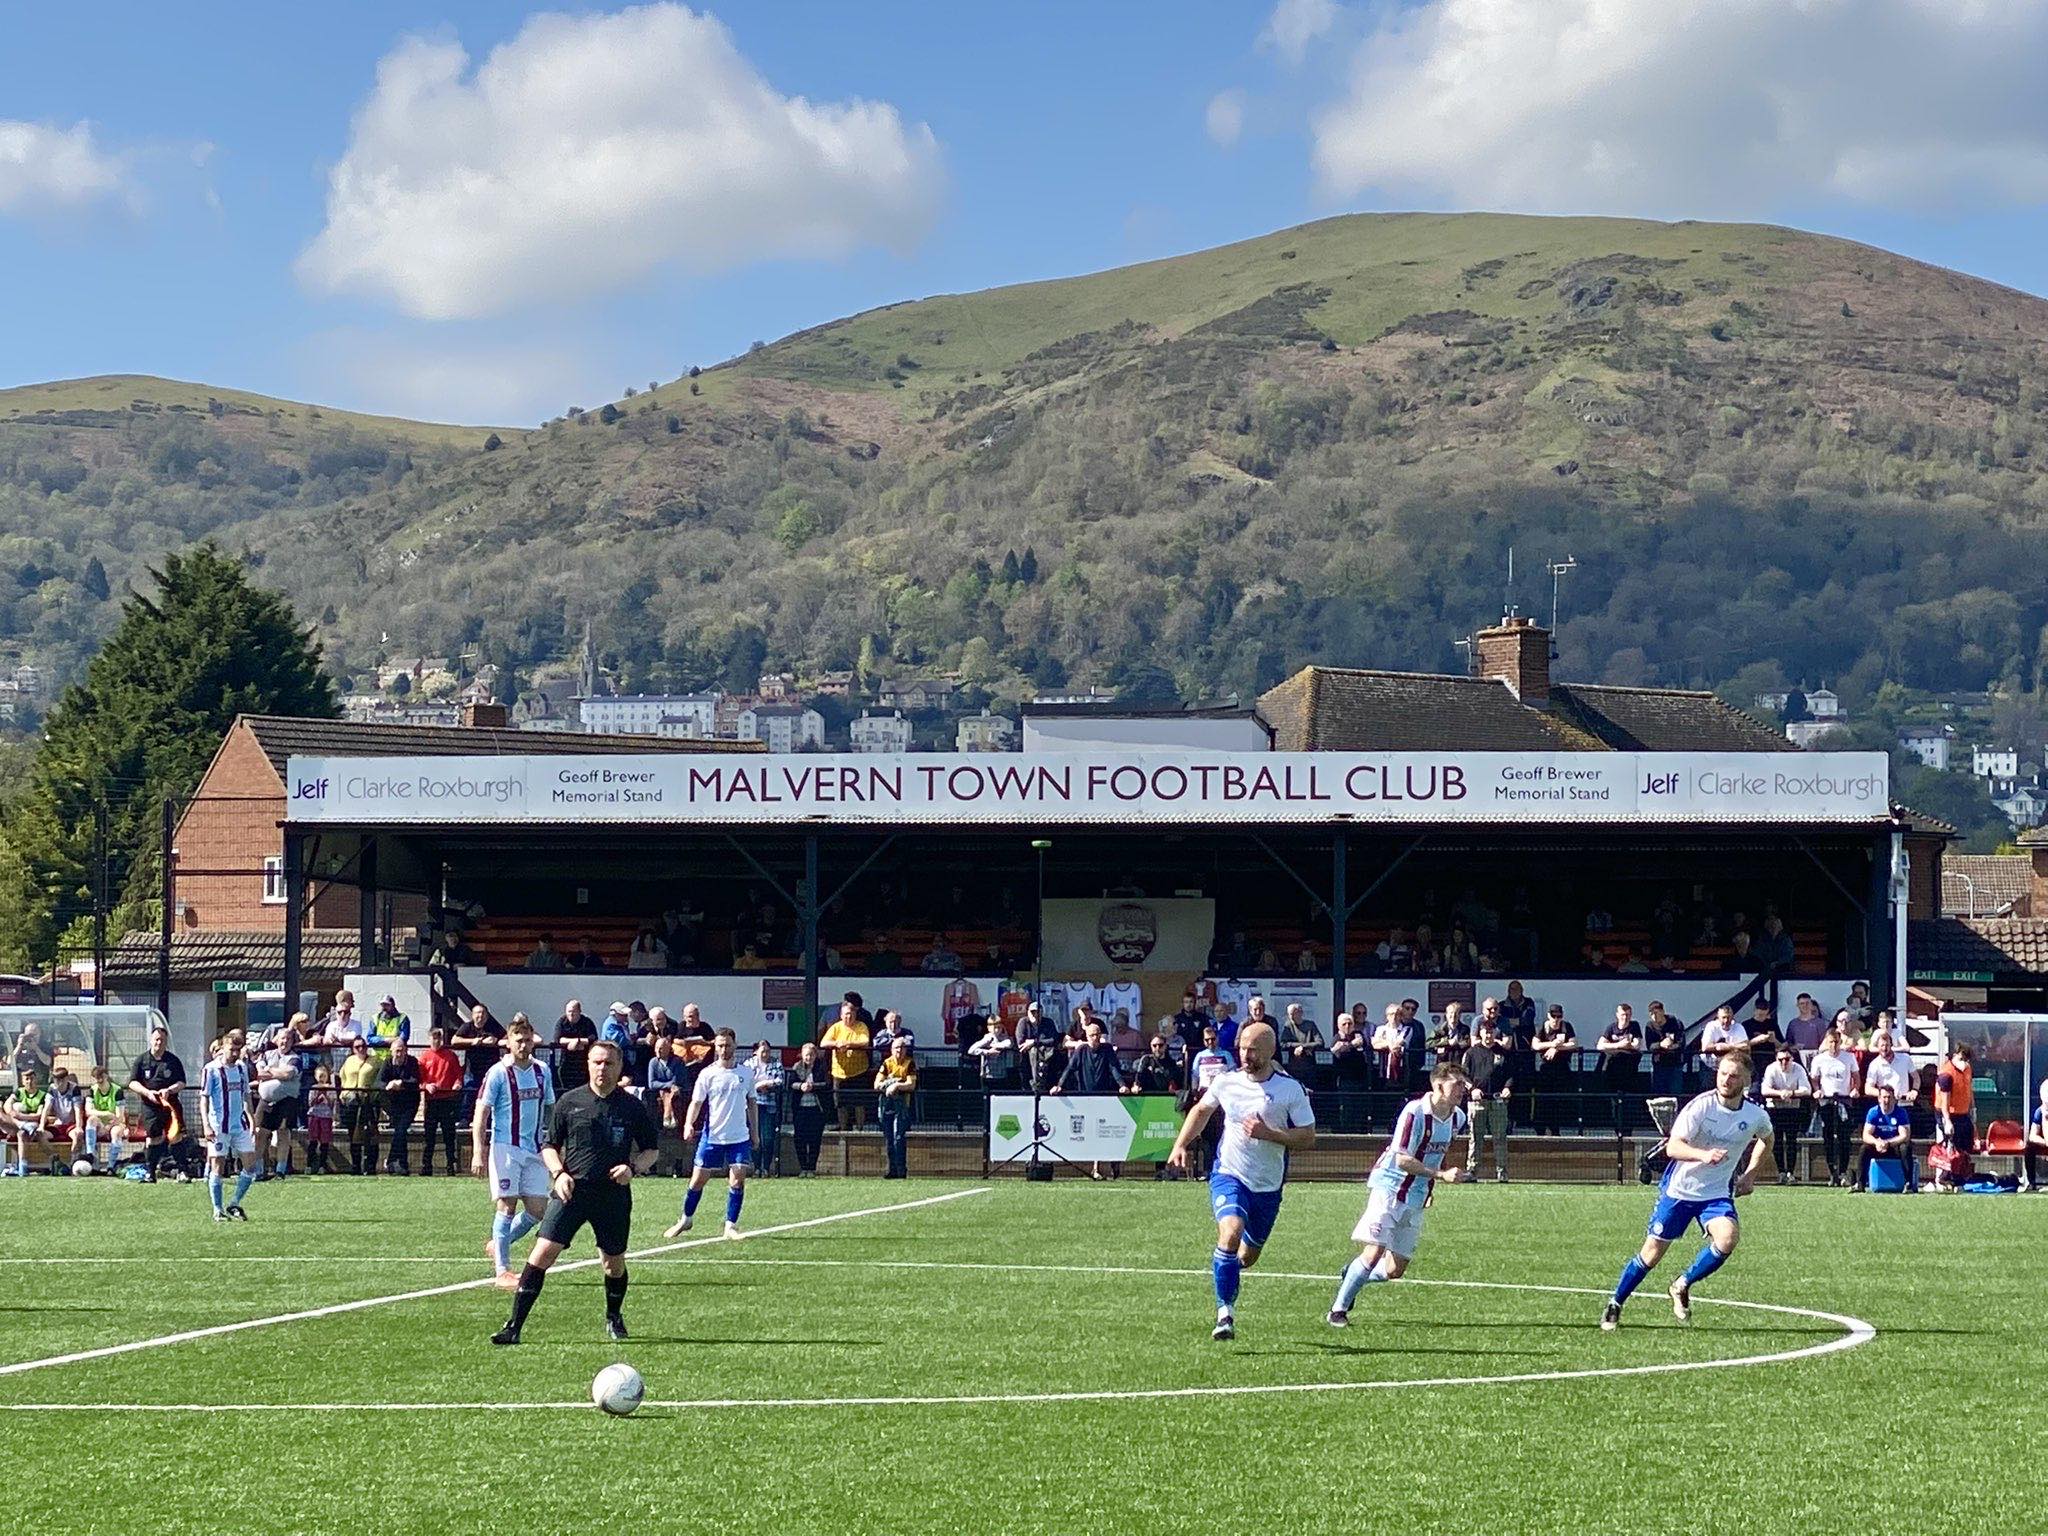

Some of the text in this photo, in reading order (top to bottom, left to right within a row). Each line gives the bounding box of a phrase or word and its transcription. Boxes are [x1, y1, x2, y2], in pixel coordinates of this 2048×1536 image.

[559, 769, 656, 783] Geoff Brewer
[1502, 766, 1602, 781] Geoff Brewer
[292, 775, 523, 802] Jelf Clarke Roxburgh
[690, 765, 1467, 802] MALVERN TOWN FOOTBALL CLUB
[1641, 772, 1884, 801] Jelf Clarke Roxburgh
[552, 788, 663, 803] Memorial Stand
[1495, 785, 1610, 801] Memorial Stand
[1913, 970, 1978, 980] EXIT EXIT
[227, 981, 285, 991] EXIT EXIT
